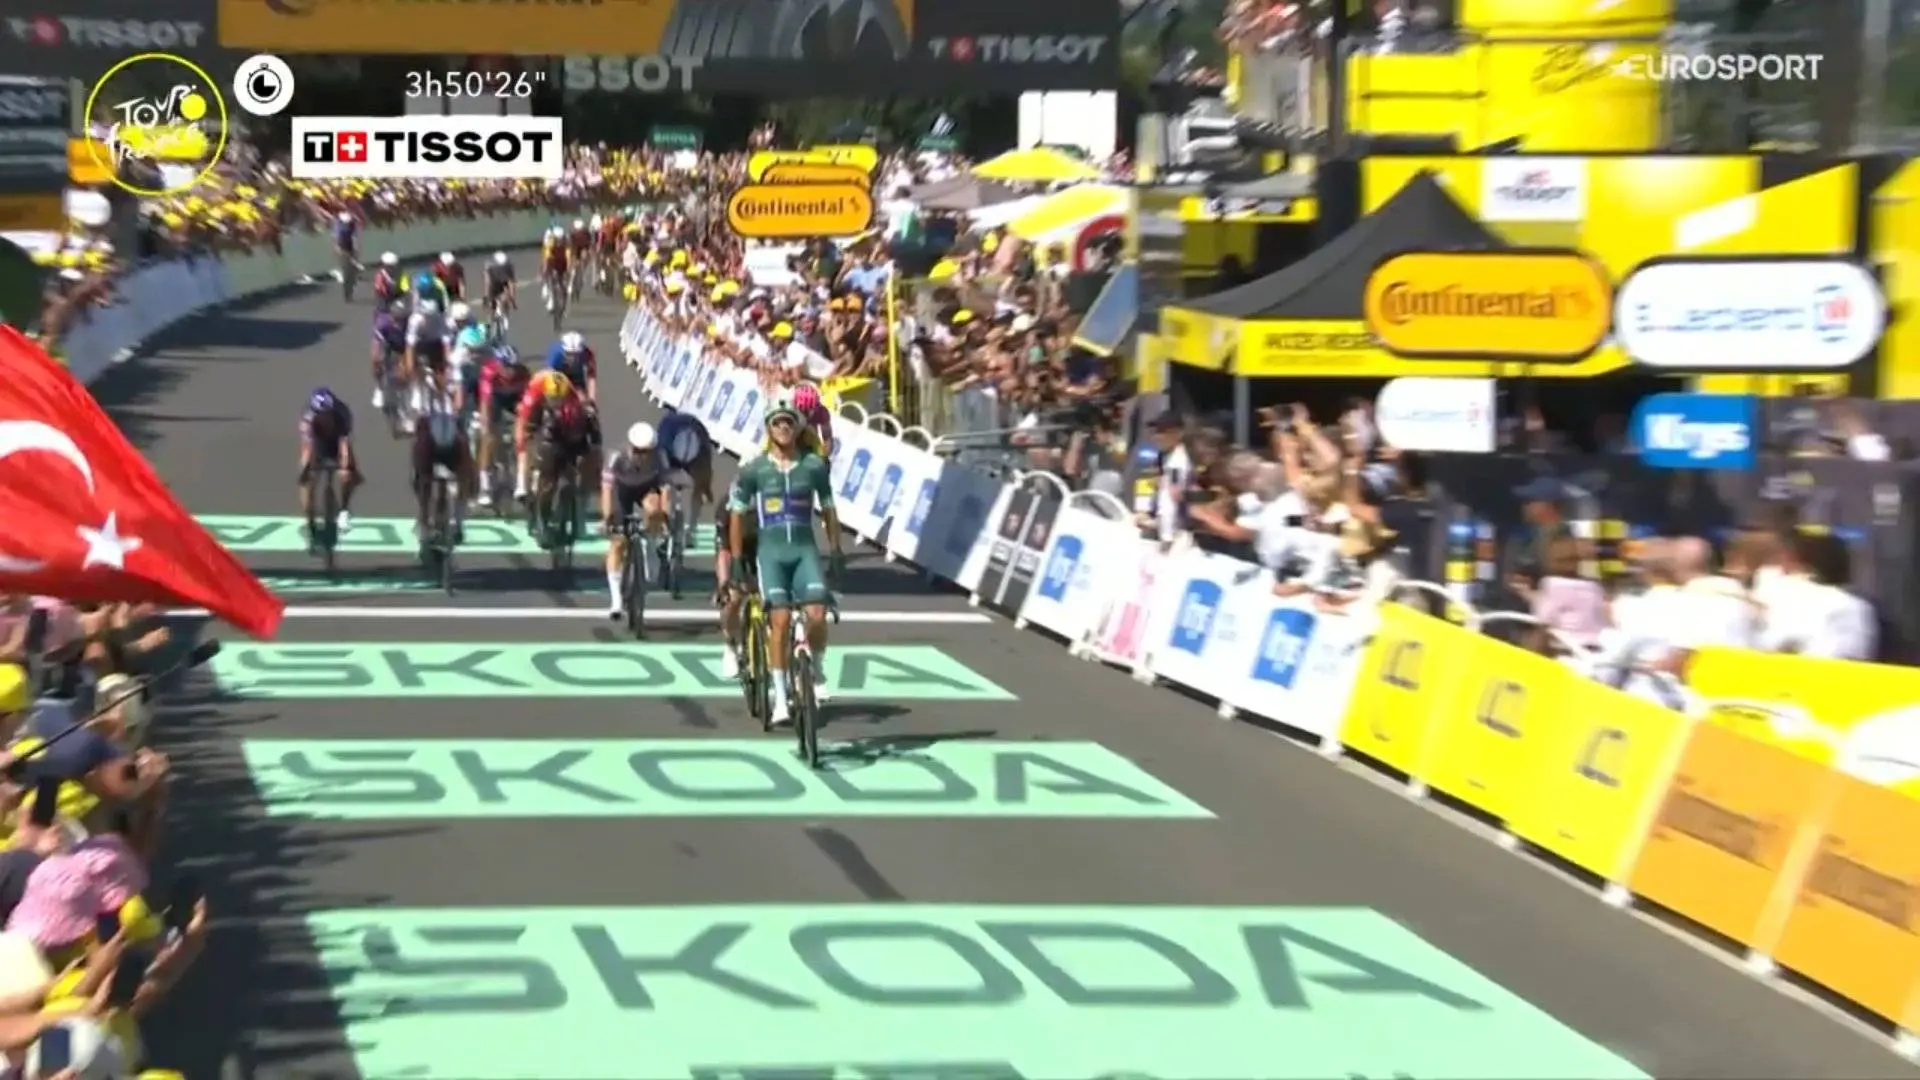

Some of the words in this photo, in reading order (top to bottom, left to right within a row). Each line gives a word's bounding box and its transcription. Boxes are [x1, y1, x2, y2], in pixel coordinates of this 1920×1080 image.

[977, 35, 1109, 64] TISSOT
[735, 195, 845, 221] Continental
[1380, 280, 1557, 325] Continental
